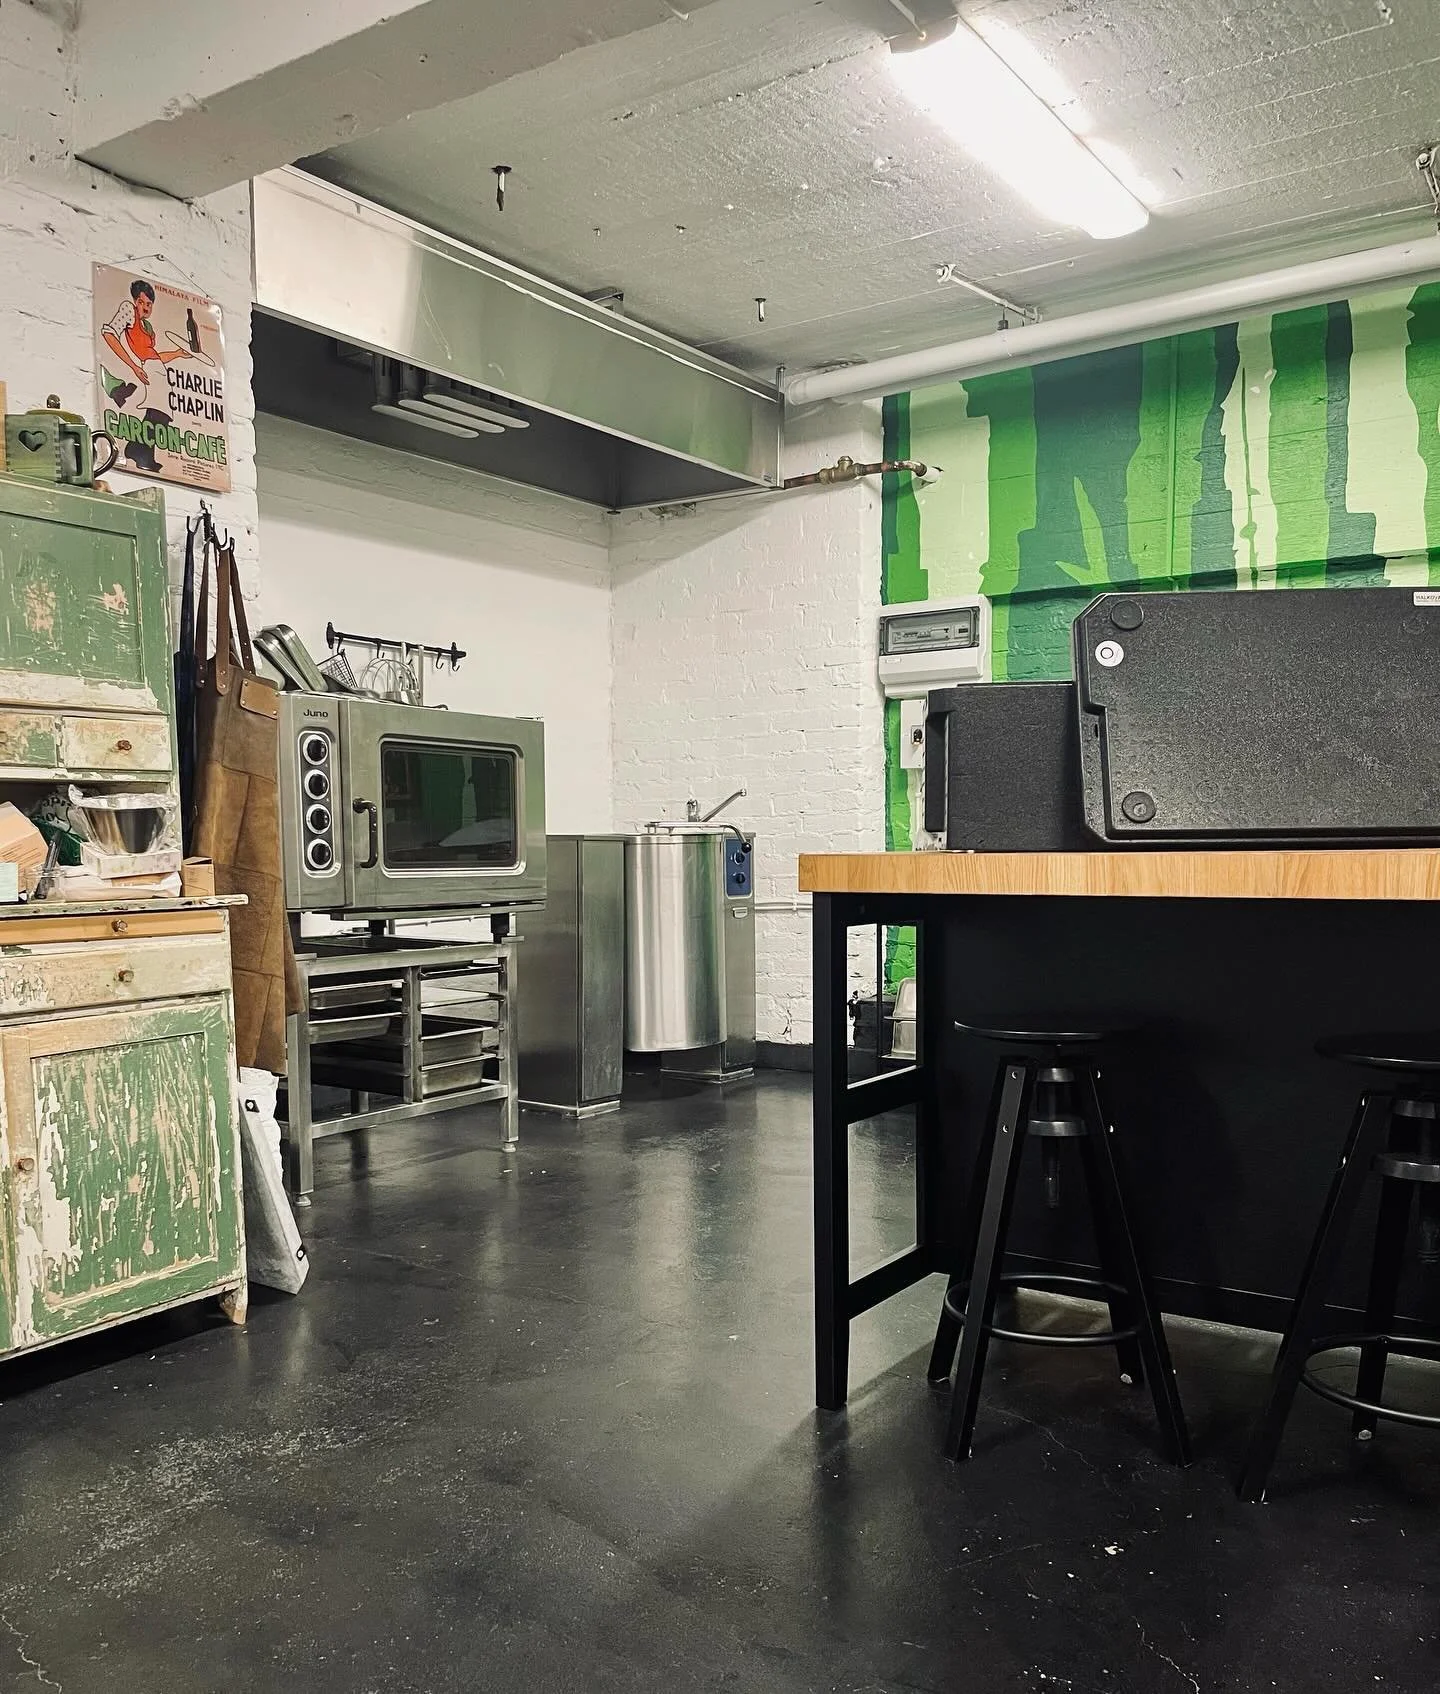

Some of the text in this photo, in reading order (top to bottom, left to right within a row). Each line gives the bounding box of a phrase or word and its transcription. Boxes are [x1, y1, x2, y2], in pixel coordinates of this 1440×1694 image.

[154, 285, 209, 306] HIMALAYA FILM
[167, 367, 223, 399] CHARLIE
[168, 391, 224, 423] CHAPLIN
[104, 409, 227, 465] GARÇON-CAFÉ
[303, 709, 328, 718] Juno
